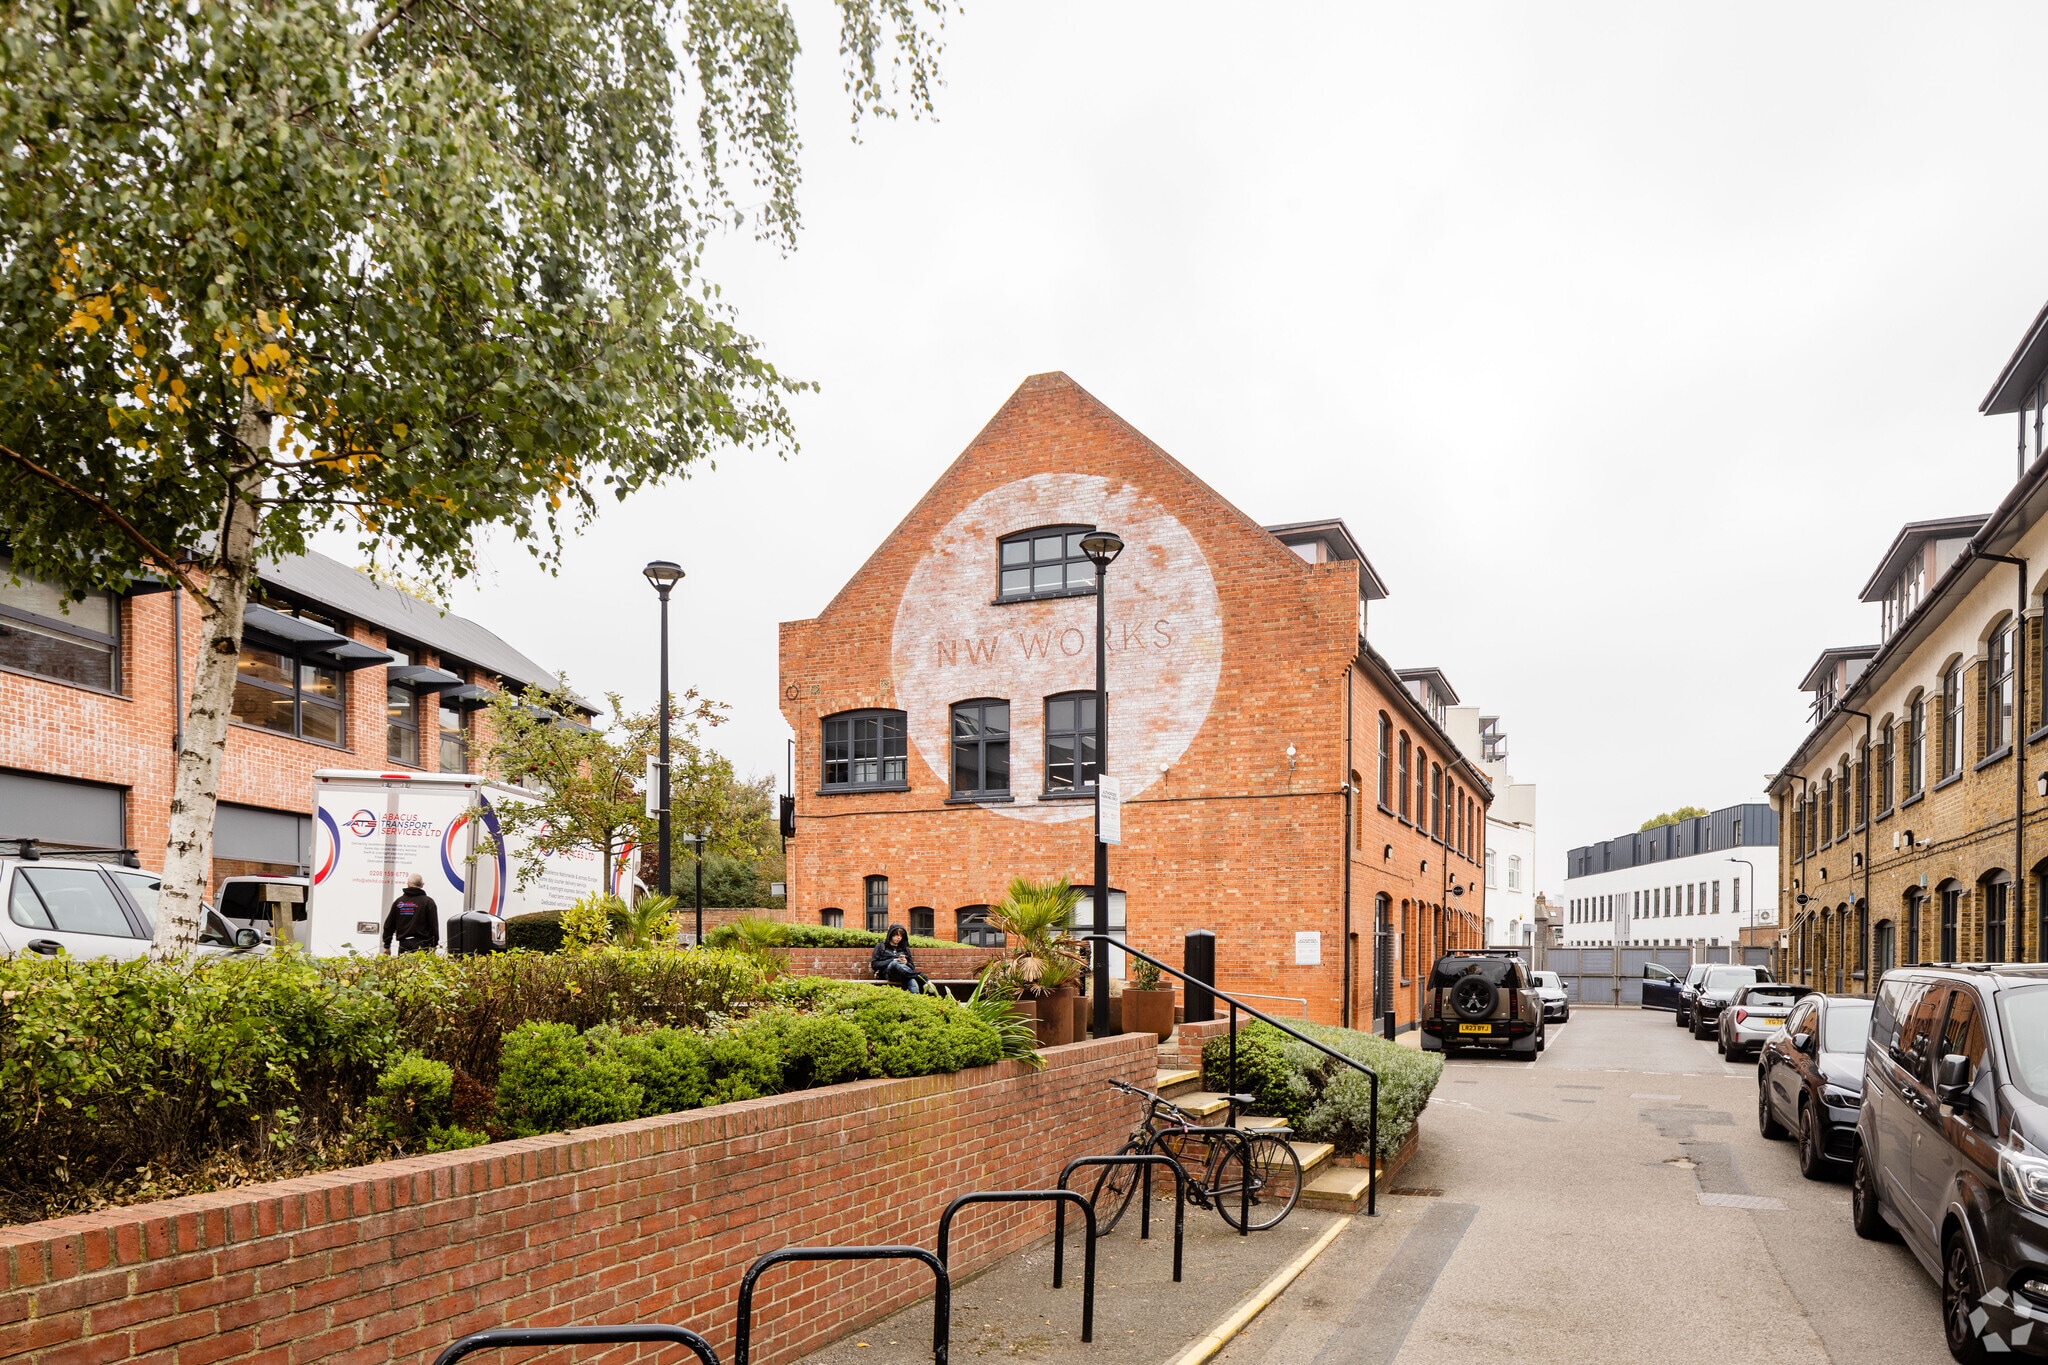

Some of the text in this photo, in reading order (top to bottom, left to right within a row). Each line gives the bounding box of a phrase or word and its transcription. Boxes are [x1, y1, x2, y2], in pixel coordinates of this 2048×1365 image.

[937, 635, 998, 668] NW
[381, 820, 432, 829] TRANSPORT
[381, 828, 442, 837] SERVICES LTD
